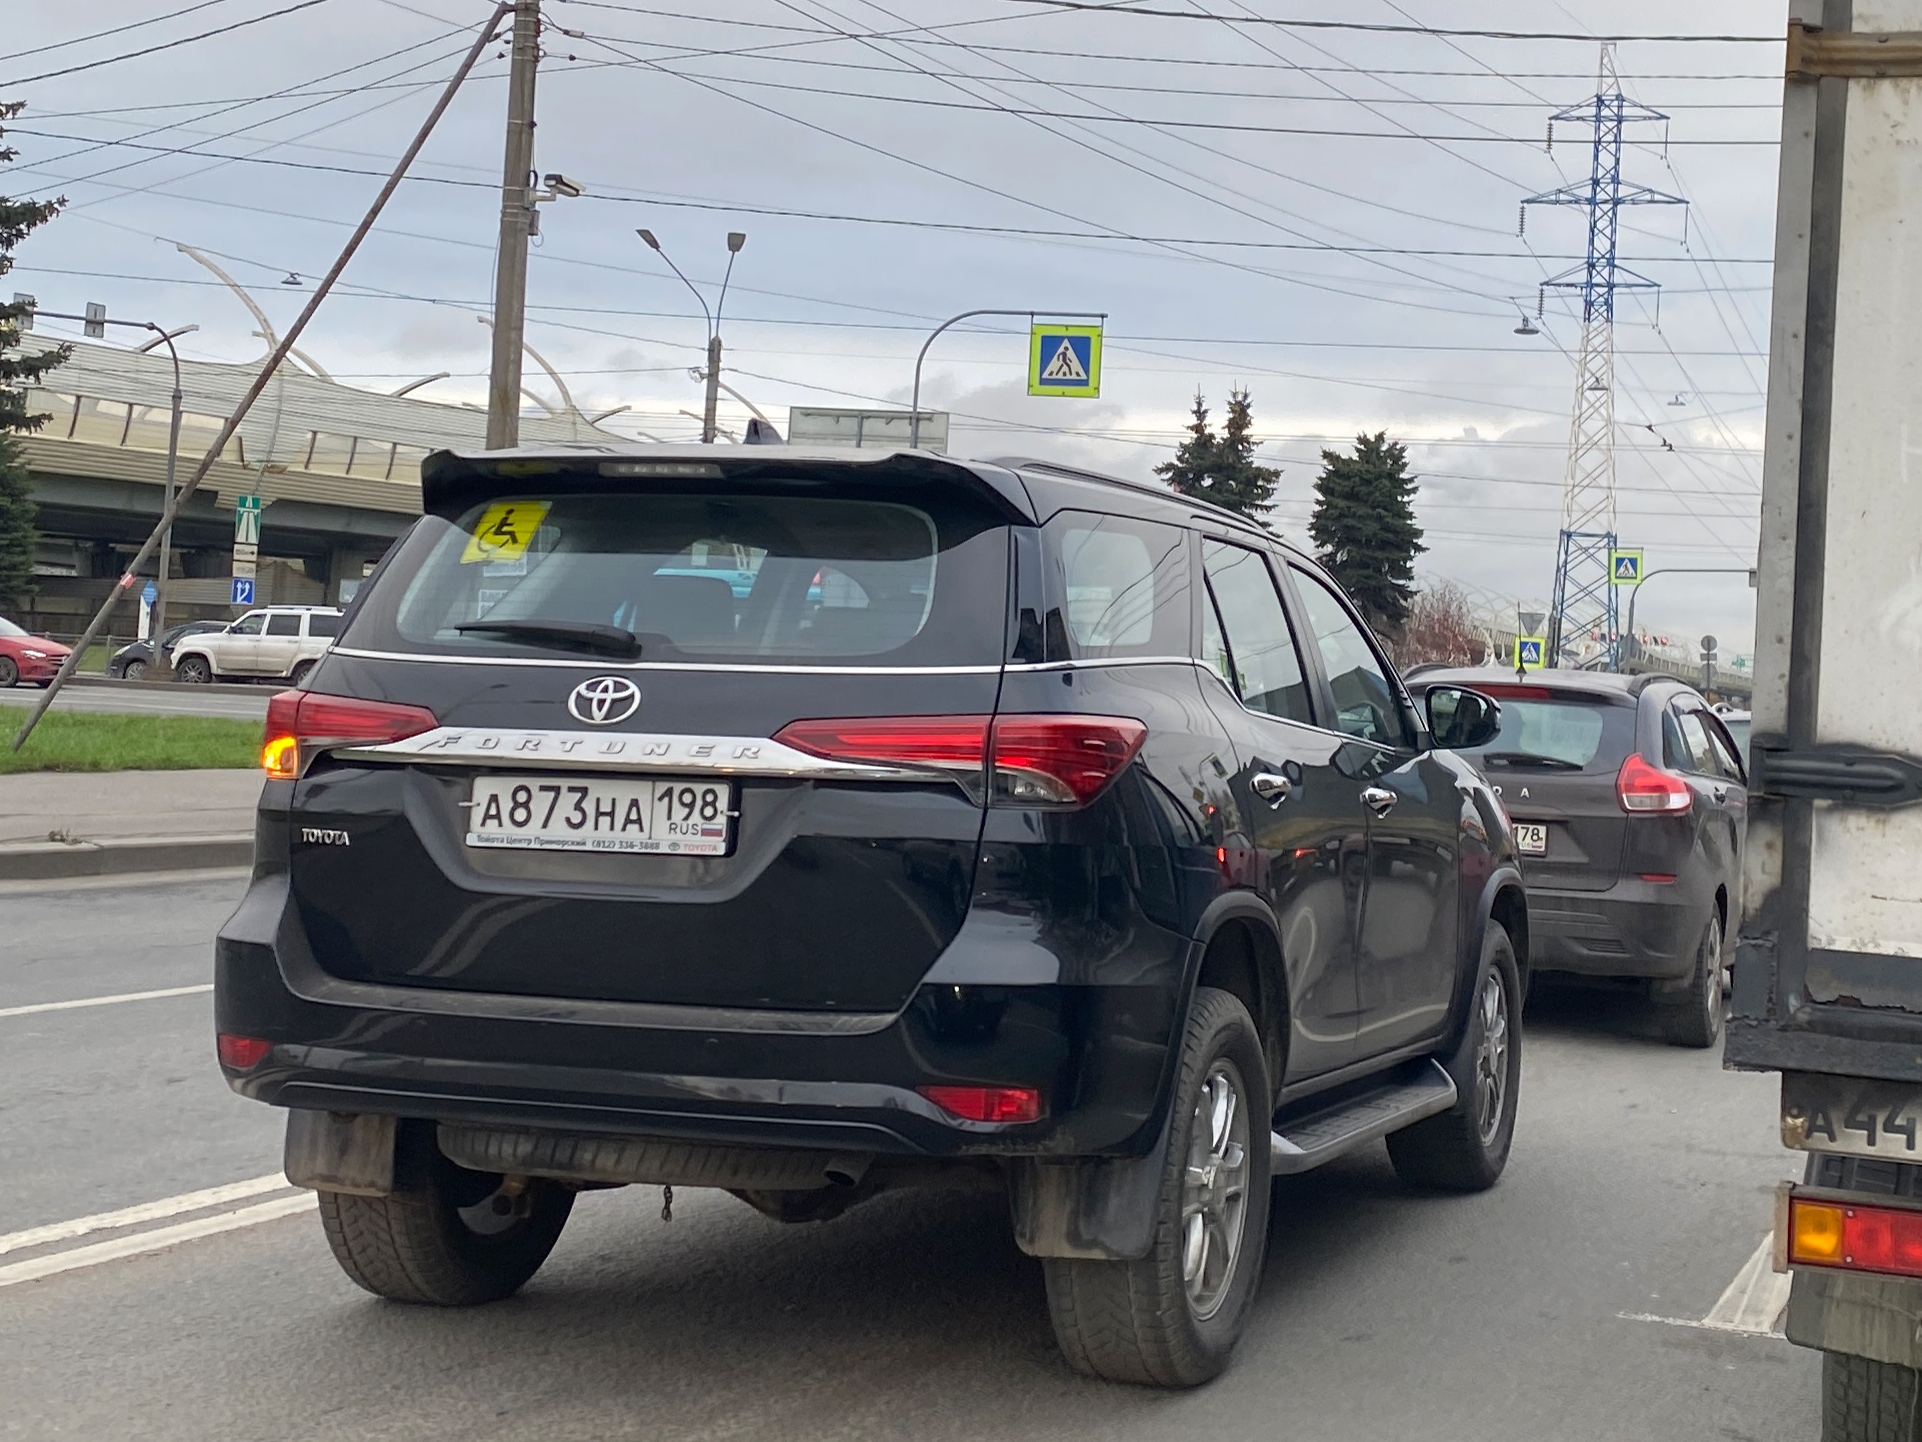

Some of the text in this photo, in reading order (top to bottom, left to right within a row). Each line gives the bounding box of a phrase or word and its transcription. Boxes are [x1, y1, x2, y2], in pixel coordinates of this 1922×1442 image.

[437, 735, 762, 760] FORTUNER
[480, 784, 645, 833] А873НА
[657, 786, 718, 822] 198
[301, 828, 350, 846] TOYOTA
[669, 822, 699, 836] RUS
[1513, 826, 1540, 842] 178
[683, 843, 718, 852] TOYOTA
[1804, 1089, 1918, 1151] А44
